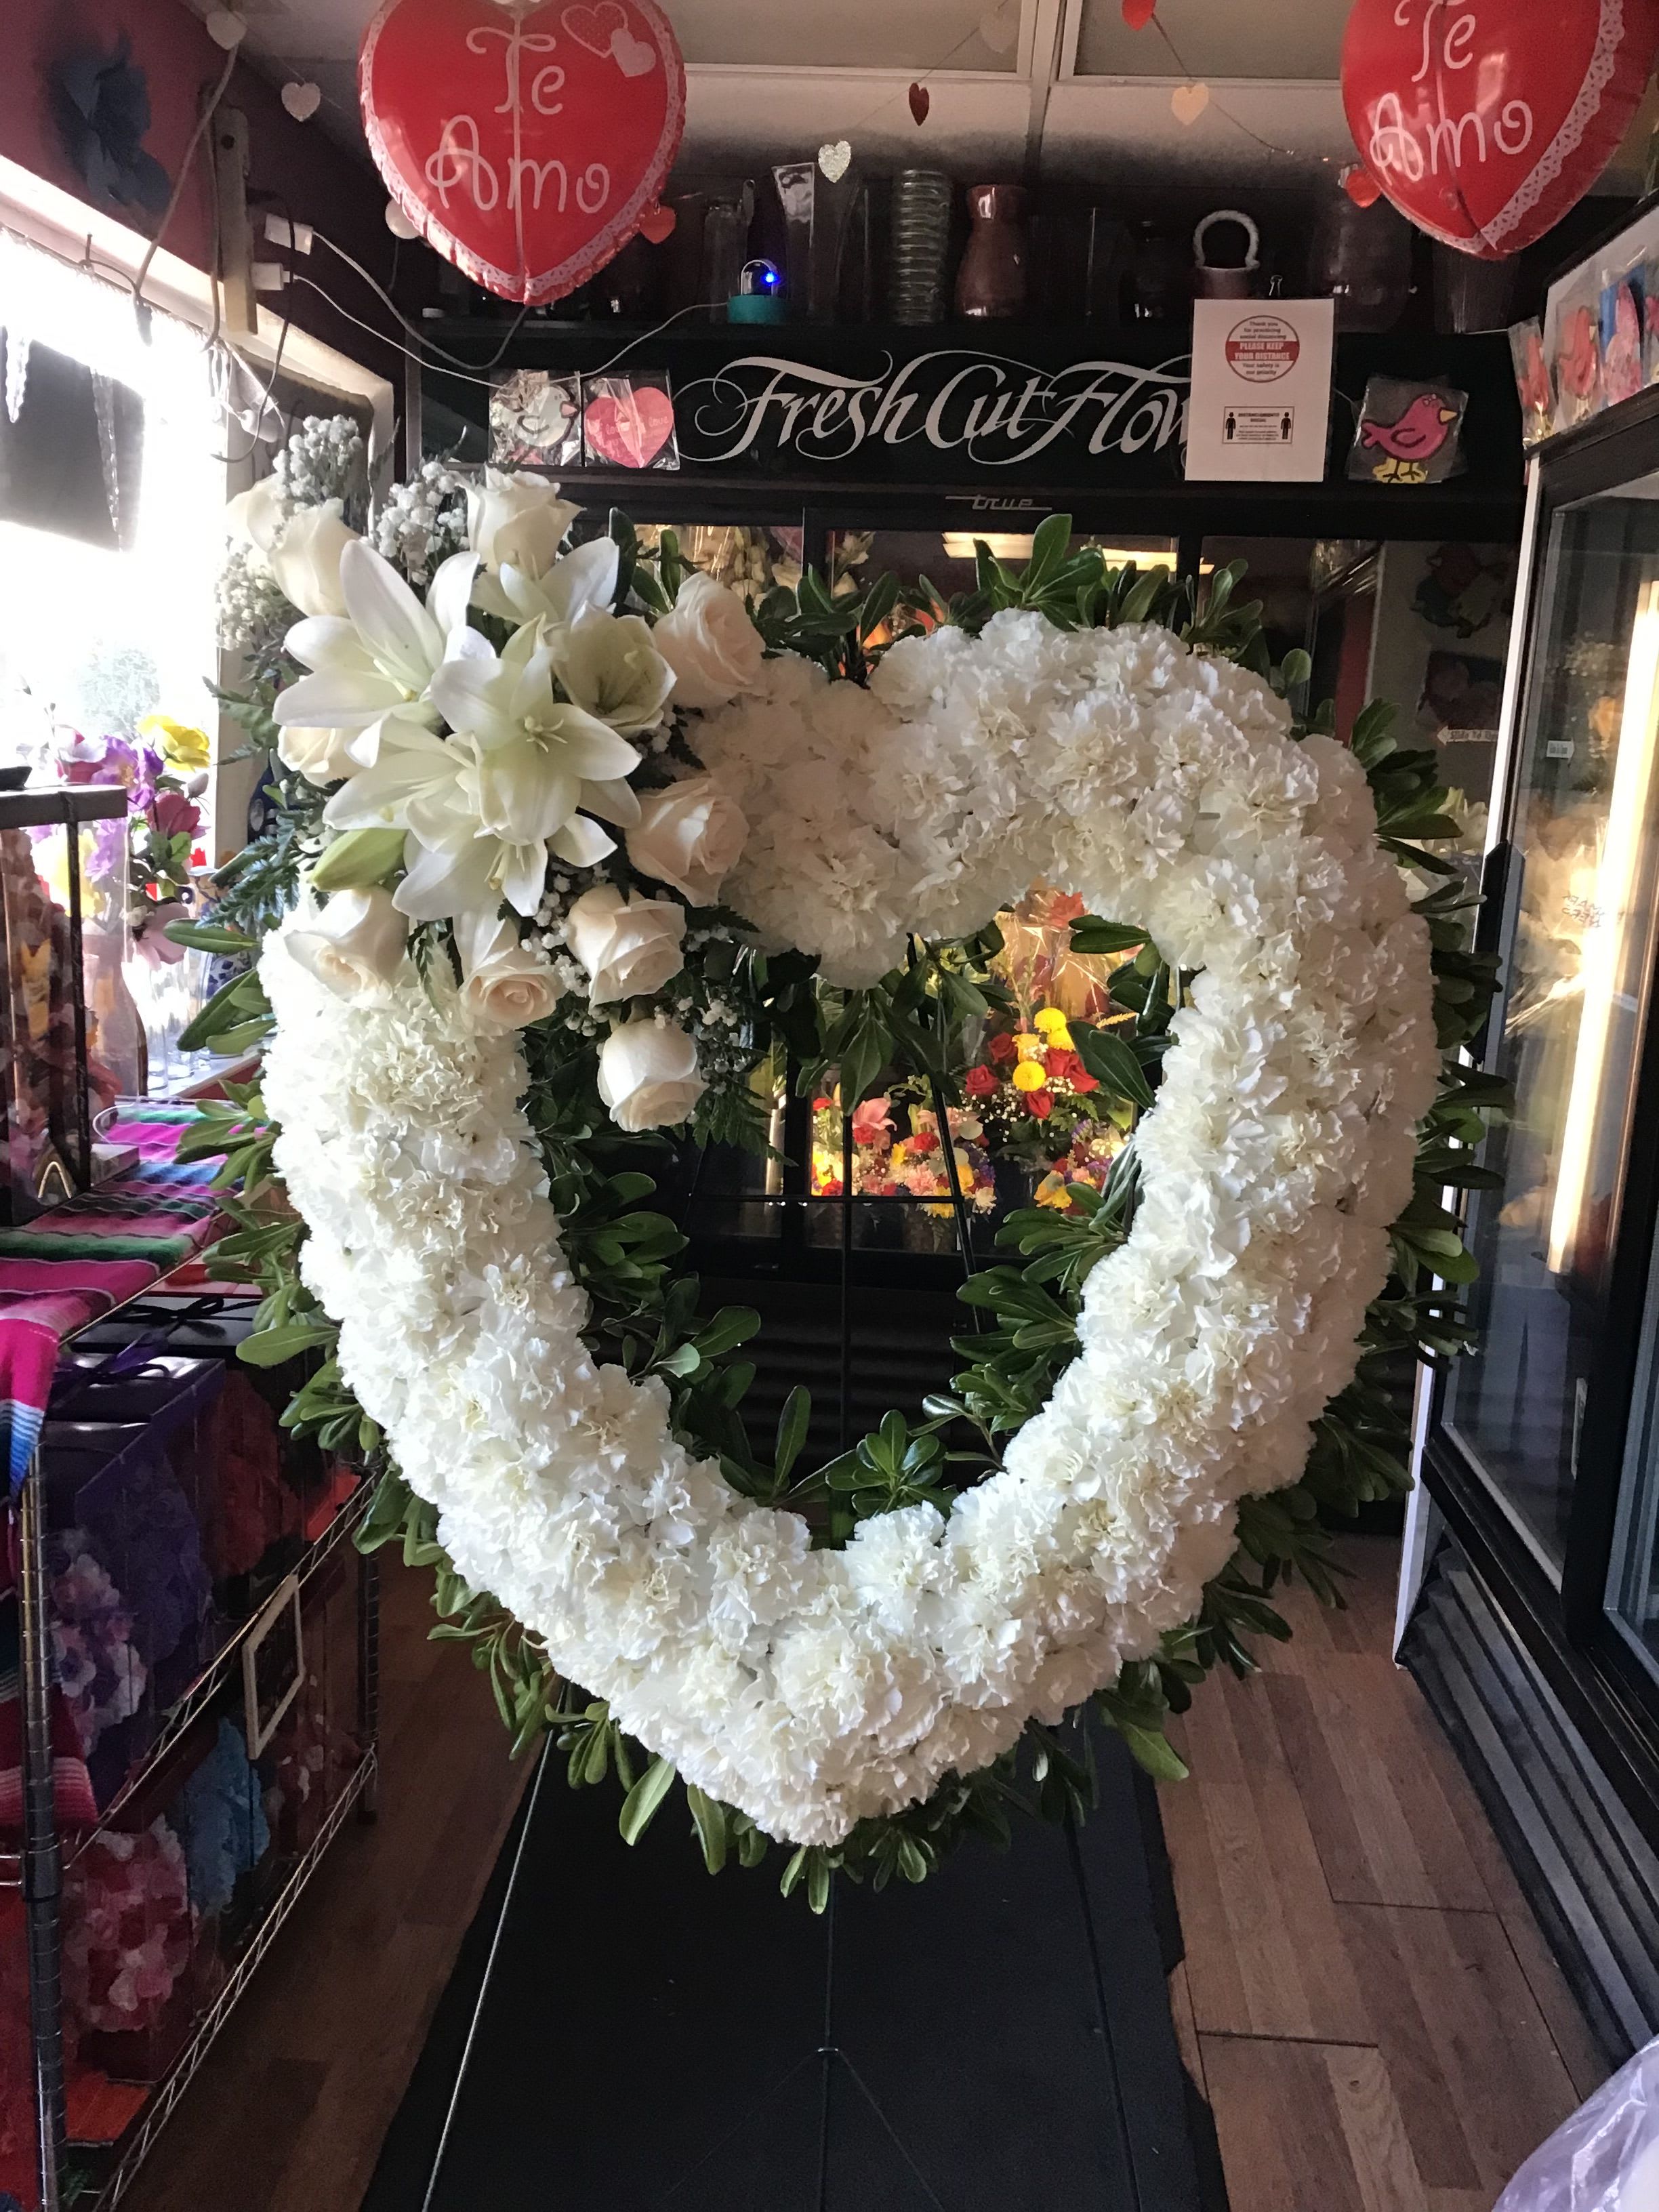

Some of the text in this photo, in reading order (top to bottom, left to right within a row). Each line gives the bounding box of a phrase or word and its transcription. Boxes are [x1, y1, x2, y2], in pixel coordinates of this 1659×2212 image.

[466, 26, 565, 115] Te
[1394, 0, 1476, 82] Te
[425, 115, 610, 213] Amo
[1369, 92, 1533, 186] Amo
[1234, 352, 1290, 361] YOUR DISTANCE
[1240, 342, 1284, 350] PLEASE KEEP
[672, 349, 1191, 465] Fresh Cut Flow
[945, 494, 1052, 511] true
